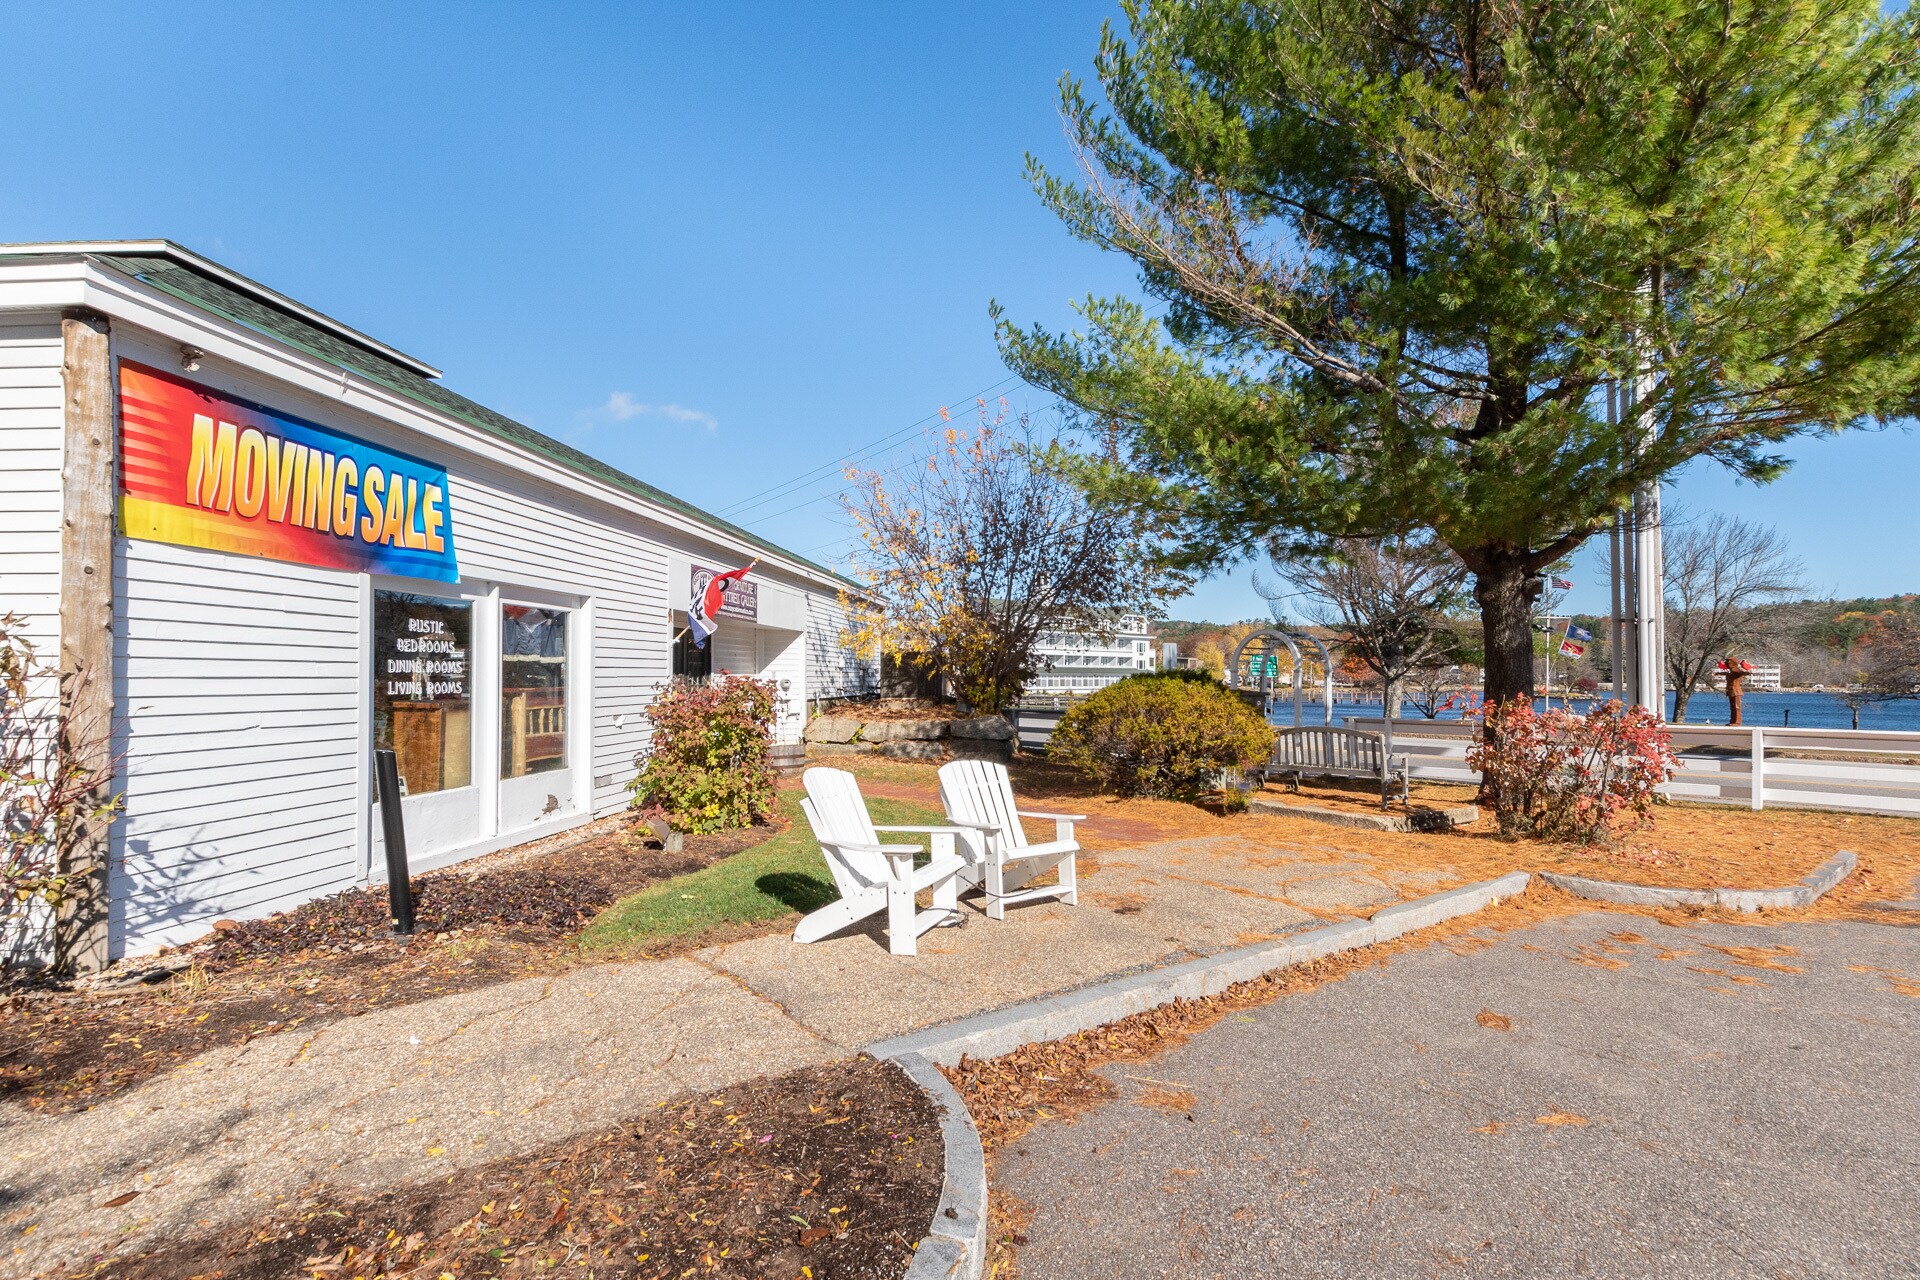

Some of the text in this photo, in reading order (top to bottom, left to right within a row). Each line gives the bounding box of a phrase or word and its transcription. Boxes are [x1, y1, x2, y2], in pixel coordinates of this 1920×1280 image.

[185, 412, 446, 554] MOVING SALE
[408, 618, 444, 634] RUSTIC
[396, 638, 456, 653] BEDROOMS
[387, 659, 462, 673] DINING ROOMS
[387, 681, 462, 695] LIVING ROOMS
